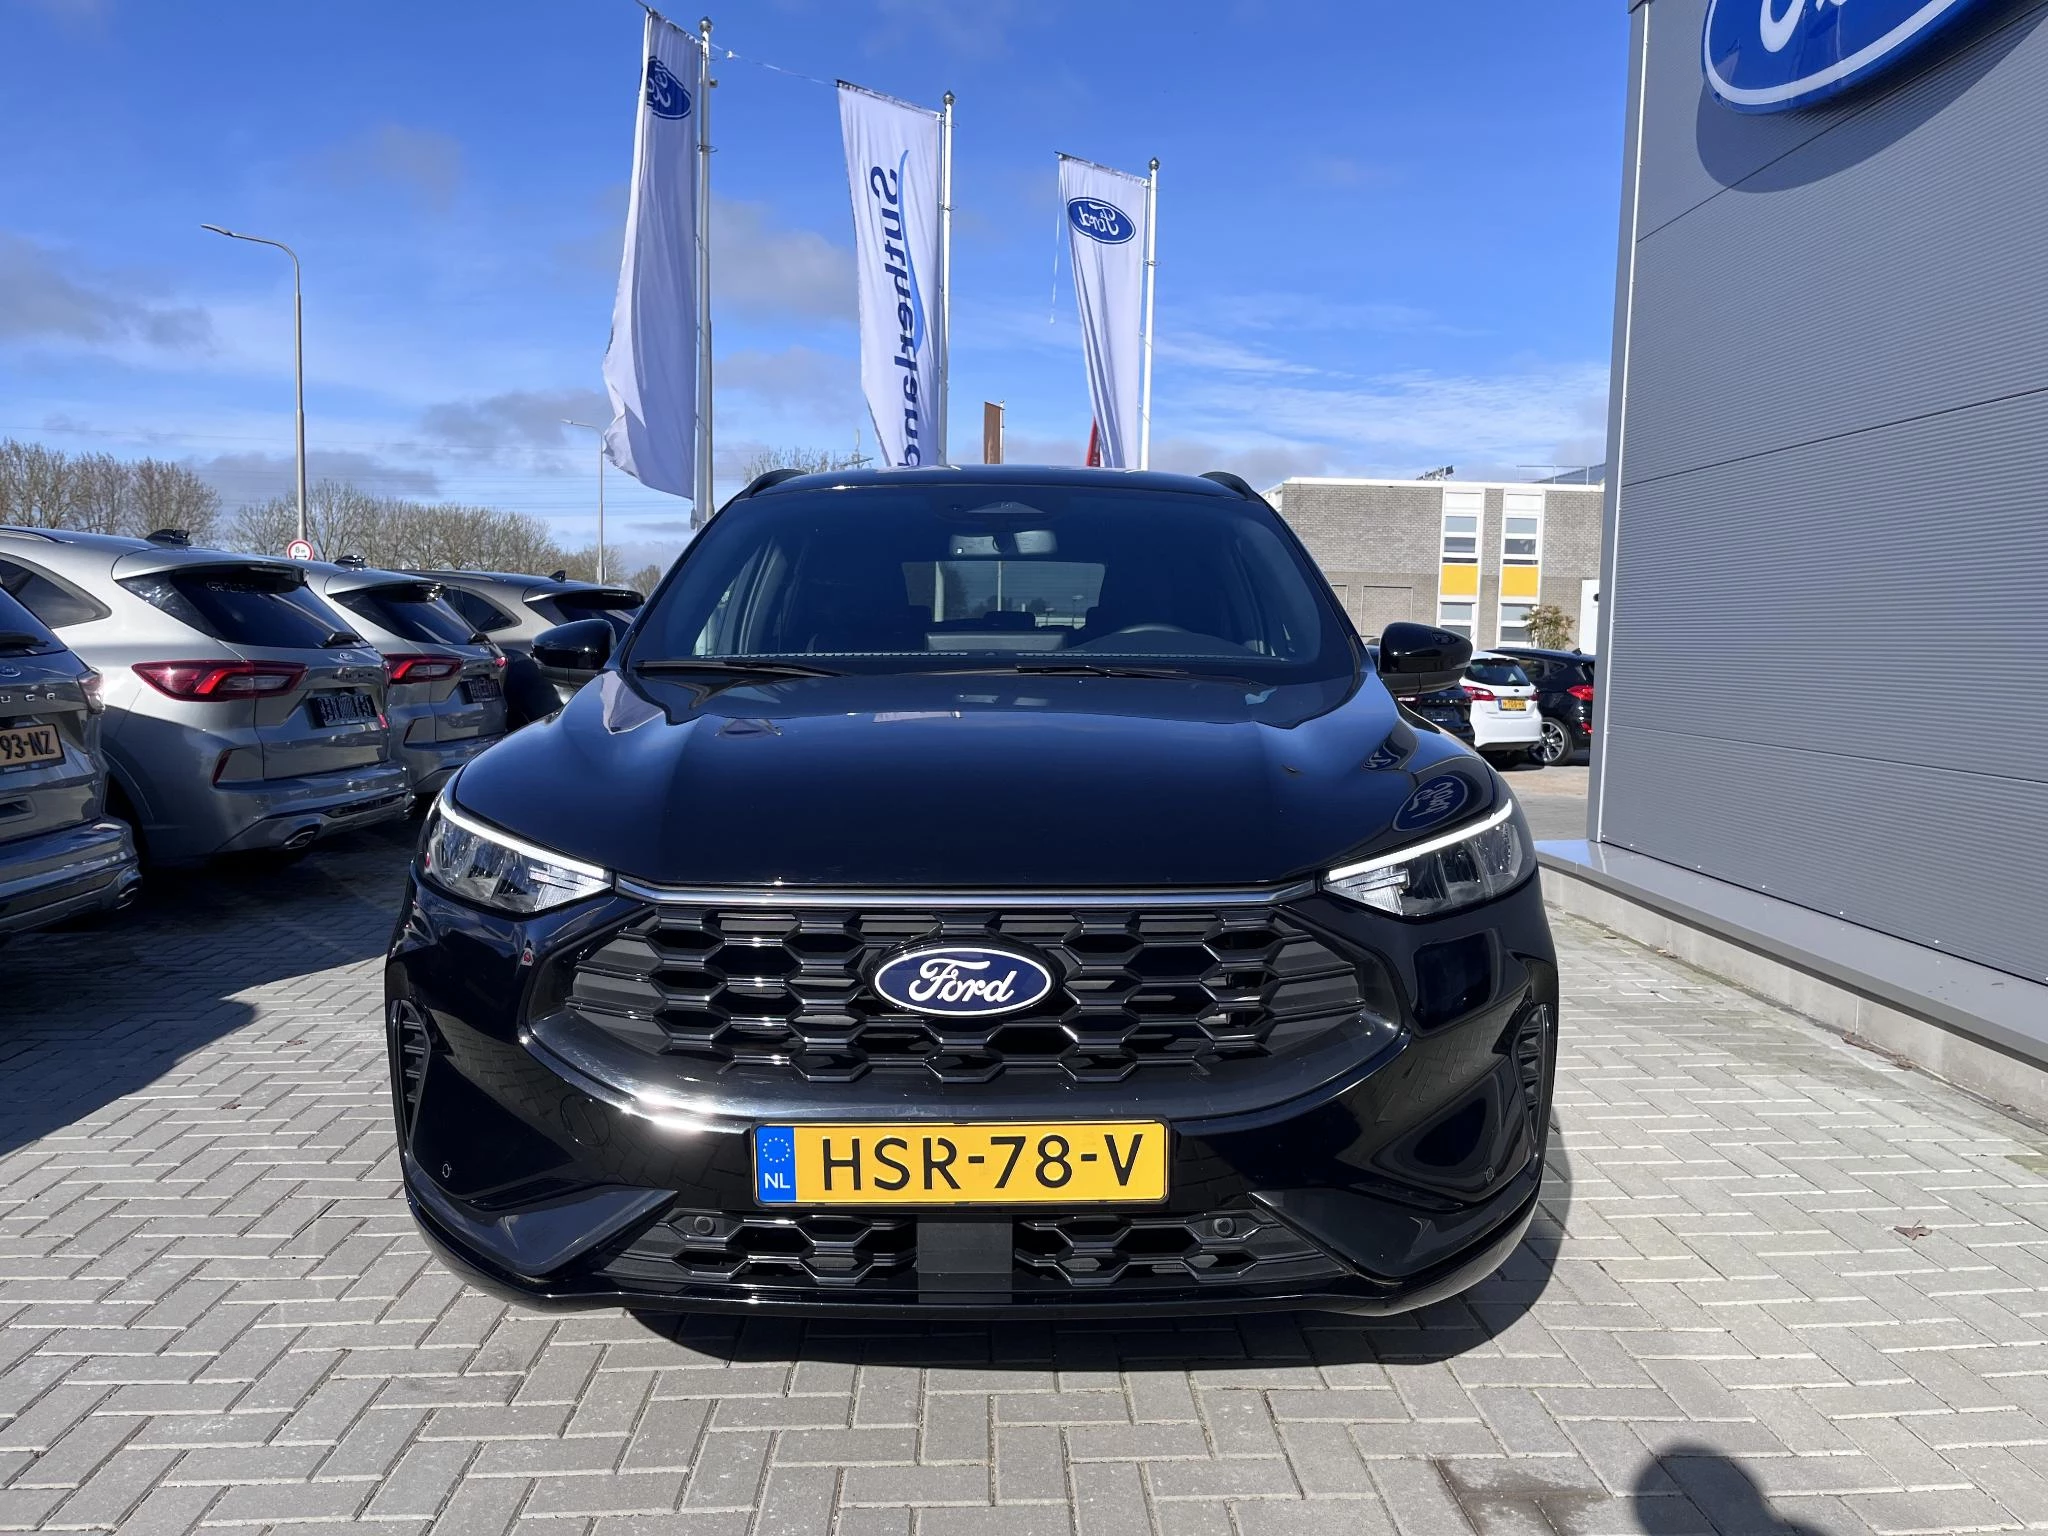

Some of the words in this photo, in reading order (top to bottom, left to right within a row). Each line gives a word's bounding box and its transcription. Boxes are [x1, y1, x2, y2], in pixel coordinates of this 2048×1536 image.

[908, 958, 1018, 1002] Ford
[764, 1172, 791, 1189] NL
[821, 1133, 1144, 1191] HSR-78-V
